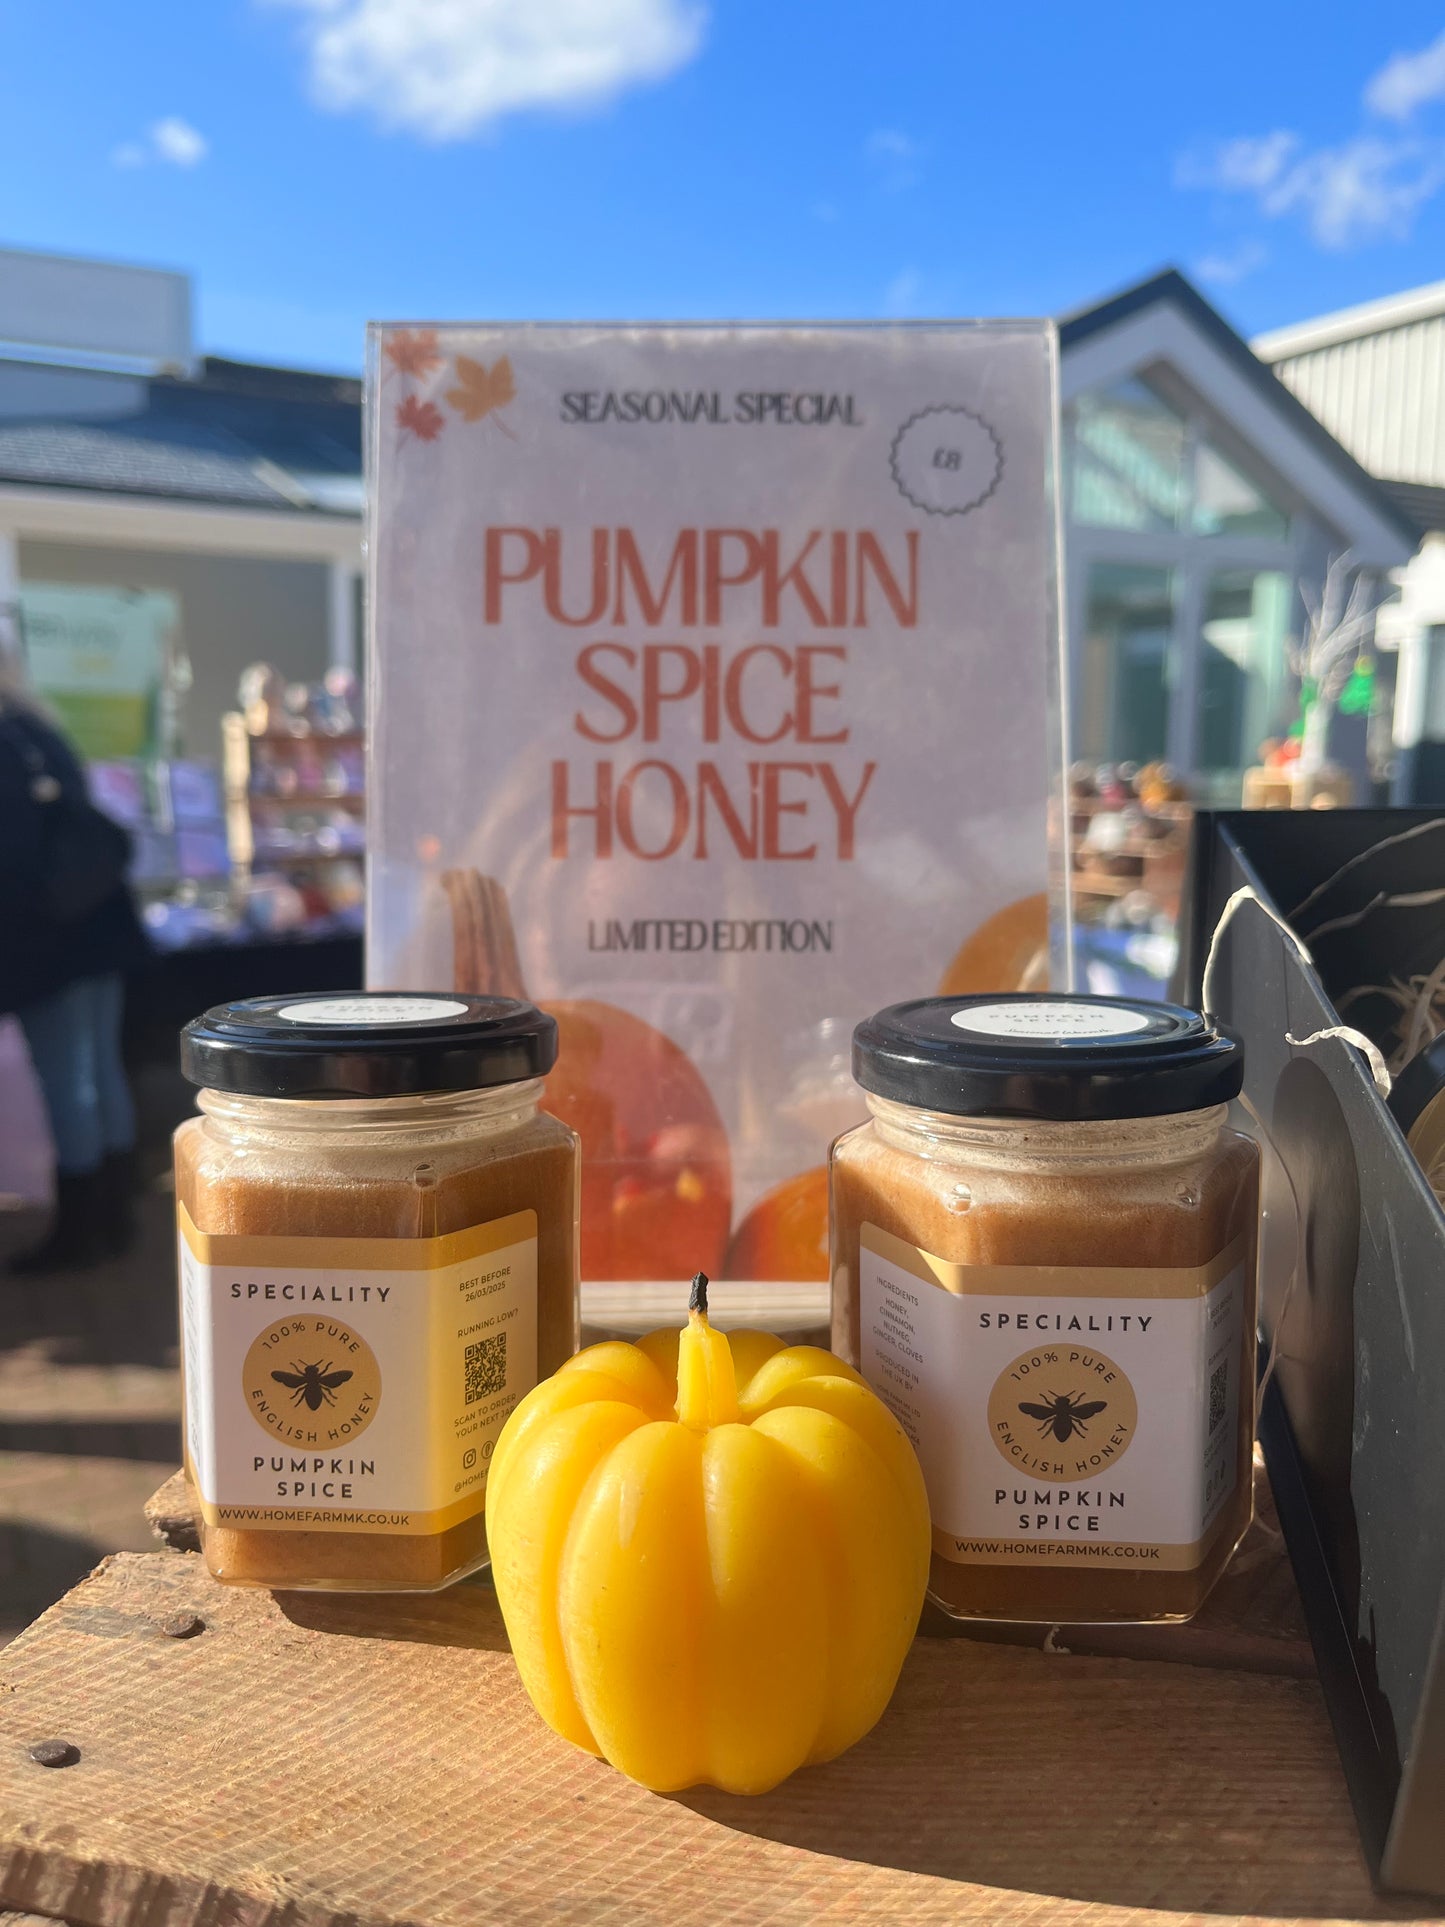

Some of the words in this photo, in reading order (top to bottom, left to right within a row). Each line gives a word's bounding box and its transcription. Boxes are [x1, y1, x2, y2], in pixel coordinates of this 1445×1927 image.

[560, 391, 729, 425] SEASONAL
[734, 391, 863, 427] SPECIAL
[484, 526, 920, 628] PUMPKIN
[573, 642, 850, 744] SPICE
[550, 759, 877, 861] HONEY
[588, 919, 708, 951] LIMITED
[712, 919, 832, 952] EDITION
[231, 1283, 391, 1302] SPECIALITY
[459, 1277, 479, 1291] BEST
[481, 1266, 511, 1284] BEFORE
[465, 1280, 506, 1302] 26/03/2025
[876, 1276, 919, 1306] INGREDIENTS
[879, 1306, 916, 1335] CINNAMON,
[885, 1298, 909, 1319] HONEY,
[979, 1313, 1152, 1332] SPECIALITY
[262, 1321, 306, 1350] 100%
[315, 1322, 360, 1353] PURE
[457, 1317, 495, 1338] RUNNING
[497, 1308, 519, 1323] LOW?
[875, 1349, 911, 1379] PRODUCED
[912, 1373, 919, 1384] IN
[897, 1342, 924, 1363] CLOVES
[881, 1365, 892, 1378] THE
[894, 1373, 904, 1386] UK
[905, 1380, 914, 1393] BY
[1011, 1351, 1058, 1381] 100%
[1069, 1352, 1117, 1384] PURE
[252, 1389, 317, 1442] ENGLISH
[328, 1392, 374, 1440] HONEY
[454, 1411, 476, 1428] SCAN
[478, 1406, 488, 1416] TO
[490, 1393, 516, 1410] ORDER
[455, 1423, 478, 1439] YOUR
[480, 1412, 499, 1426] NEXT
[997, 1421, 1064, 1474] ENGLISH
[1076, 1423, 1128, 1473] HONEY
[254, 1456, 375, 1475] PUMPKIN
[277, 1481, 353, 1499] SPICE
[995, 1489, 1125, 1507] PUMPKIN
[218, 1508, 410, 1526] WWW.HOMEFARMMK.CO.UK
[1019, 1514, 1099, 1531] SPICE
[955, 1540, 1160, 1559] WWW.HOMEFARMMK.CO.UK
